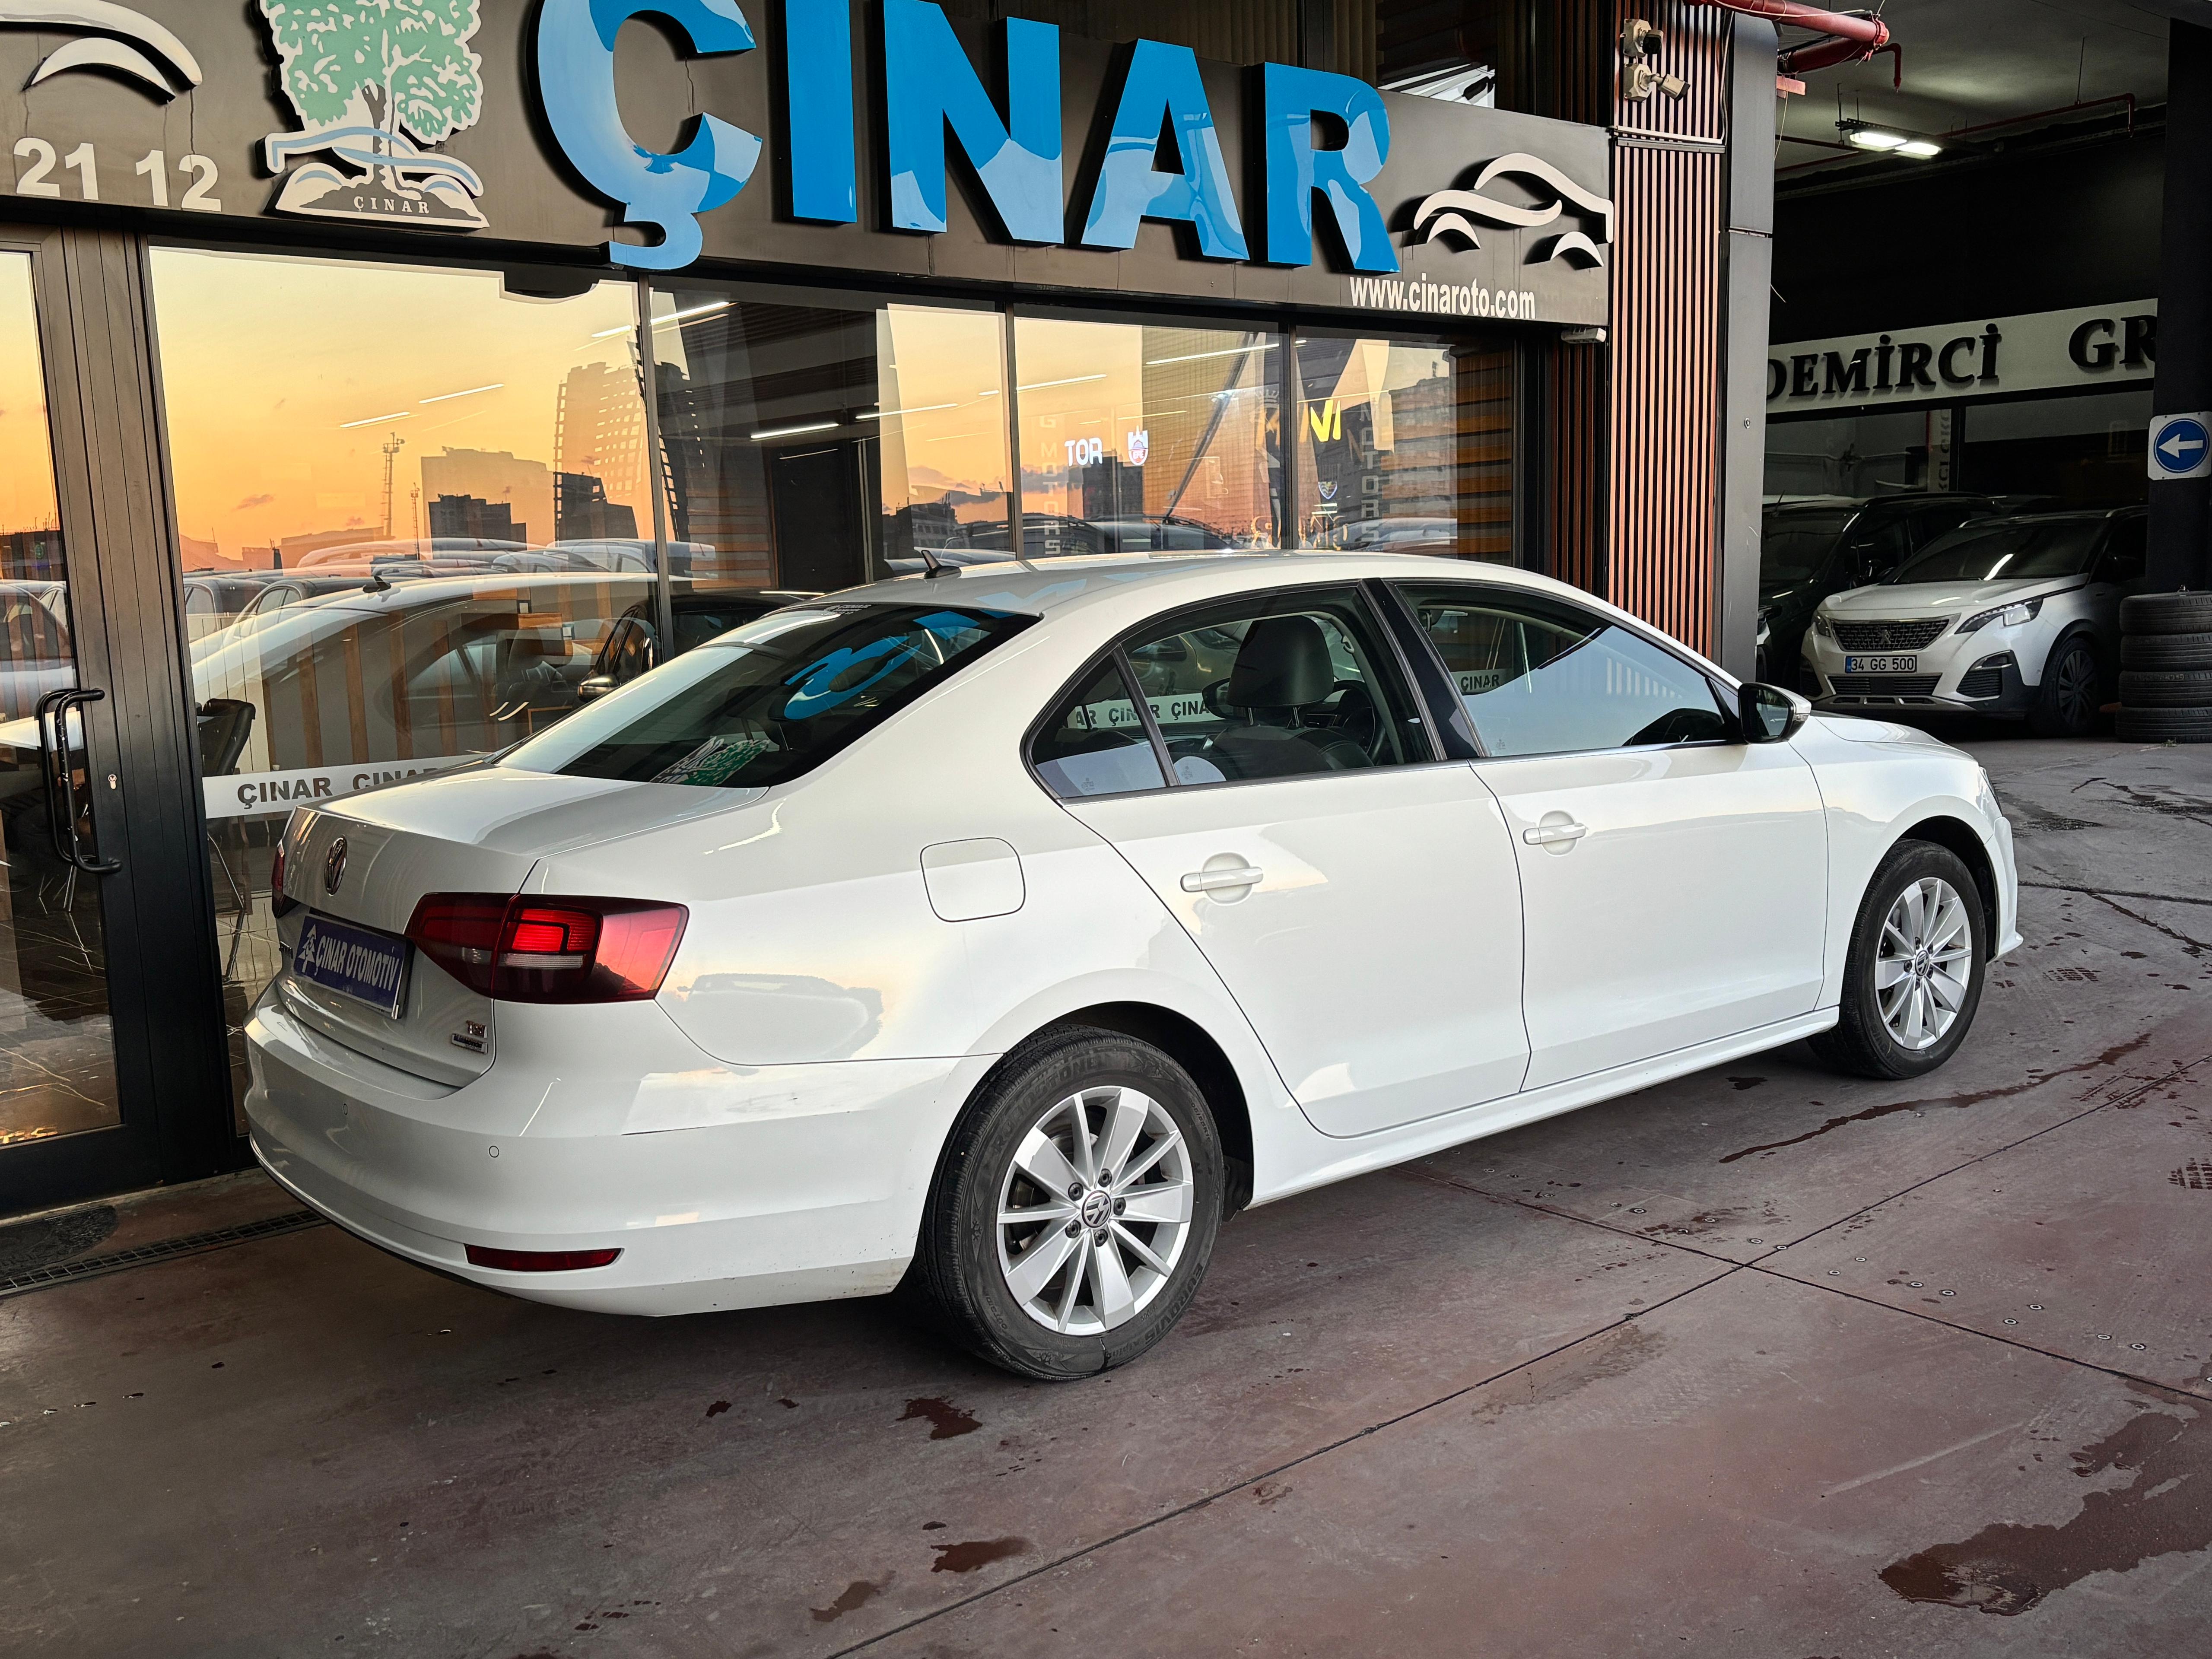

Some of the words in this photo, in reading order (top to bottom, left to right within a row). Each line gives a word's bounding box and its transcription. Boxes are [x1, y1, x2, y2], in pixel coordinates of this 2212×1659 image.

[537, 0, 1399, 270] ÇINAR
[13, 137, 99, 200] 21
[135, 149, 222, 212] 12
[354, 196, 429, 214] ÇINAR
[1350, 273, 1535, 320] www.cinaroto.com
[1851, 658, 1864, 670] 34
[1870, 658, 1887, 670] GG
[1892, 658, 1914, 670] 500
[1108, 704, 1161, 727] ÇINR
[1171, 700, 1210, 721] ÇINA
[237, 777, 333, 809] ÇINAR
[315, 935, 348, 976] ÇINAR
